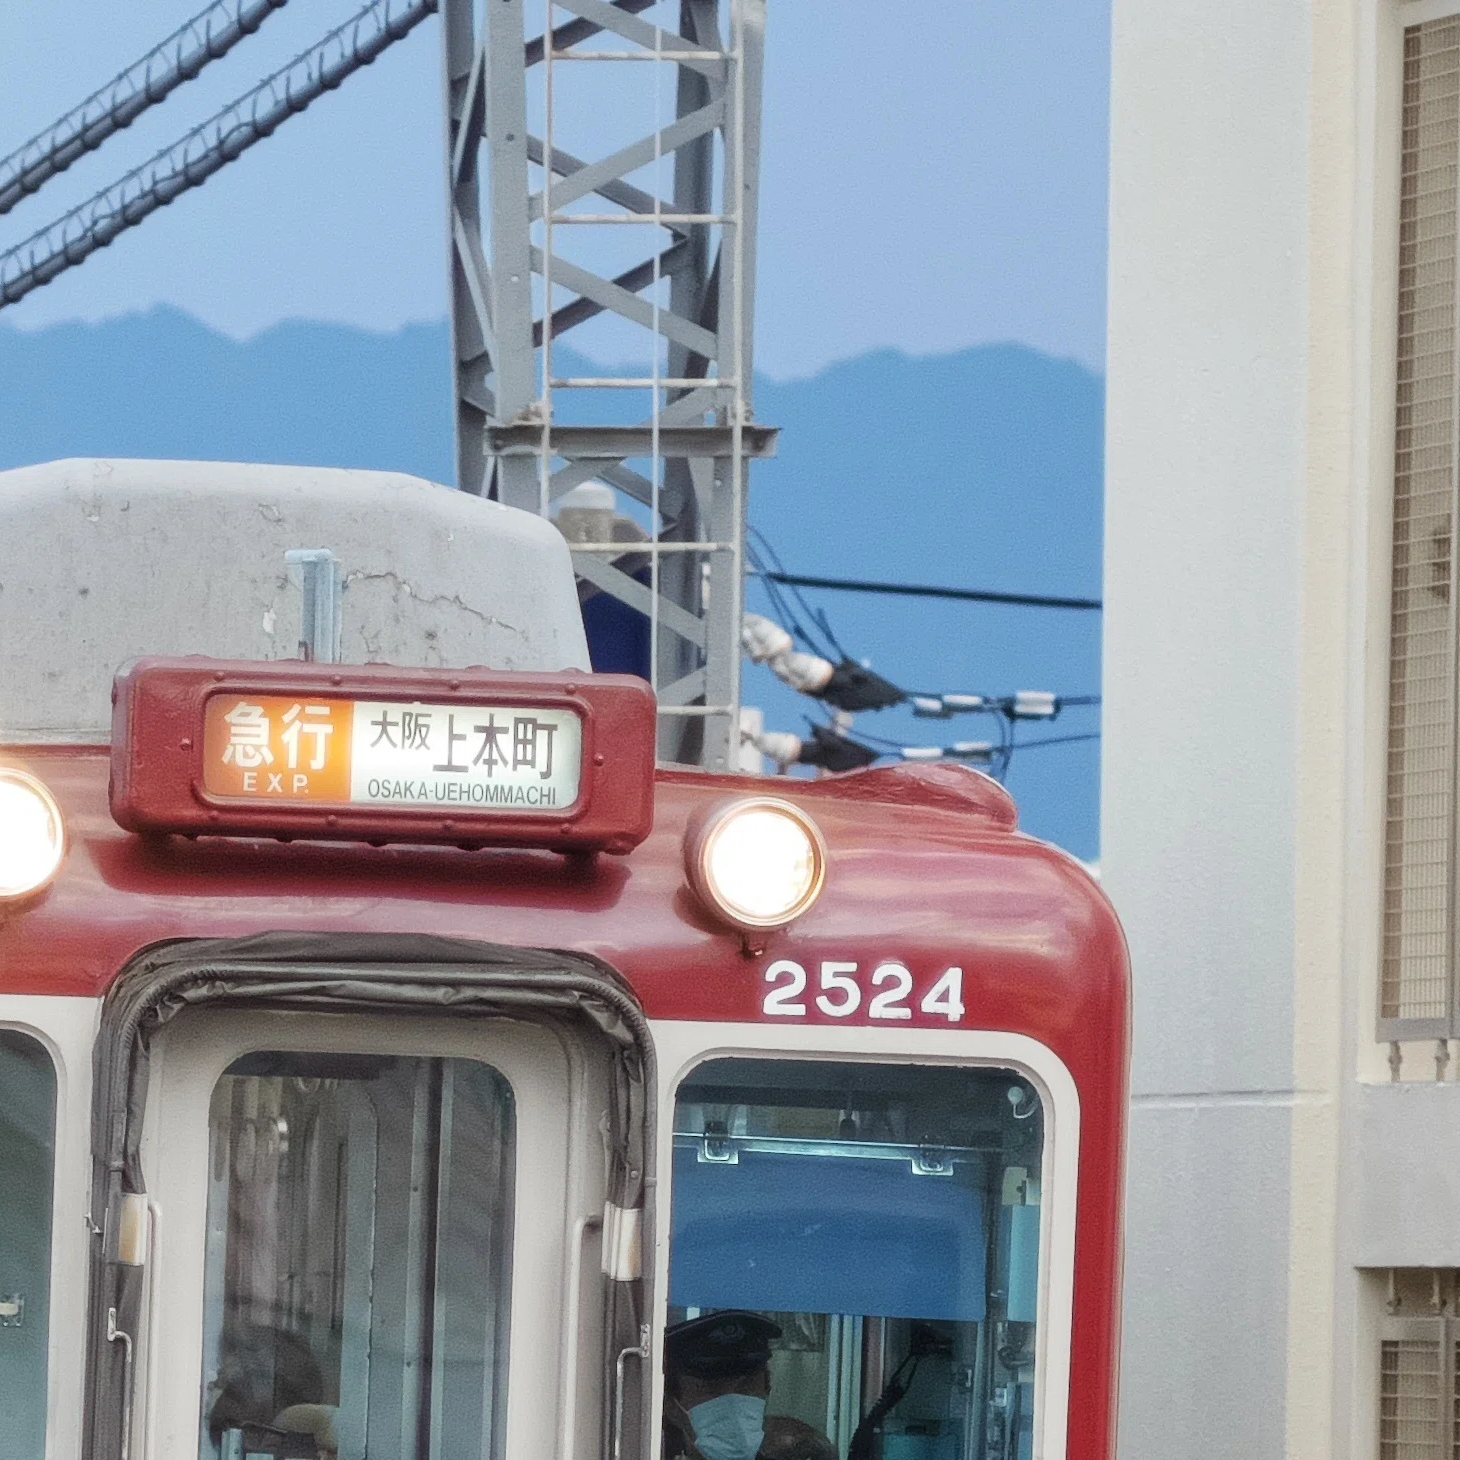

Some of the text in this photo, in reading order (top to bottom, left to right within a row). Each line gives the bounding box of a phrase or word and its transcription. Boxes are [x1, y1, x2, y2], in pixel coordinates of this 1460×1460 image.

[221, 701, 334, 770] 急行
[370, 709, 558, 780] 大阪上本町
[368, 778, 557, 806] OSAKA-UEHOMMACHI
[762, 960, 965, 1022] 2524
